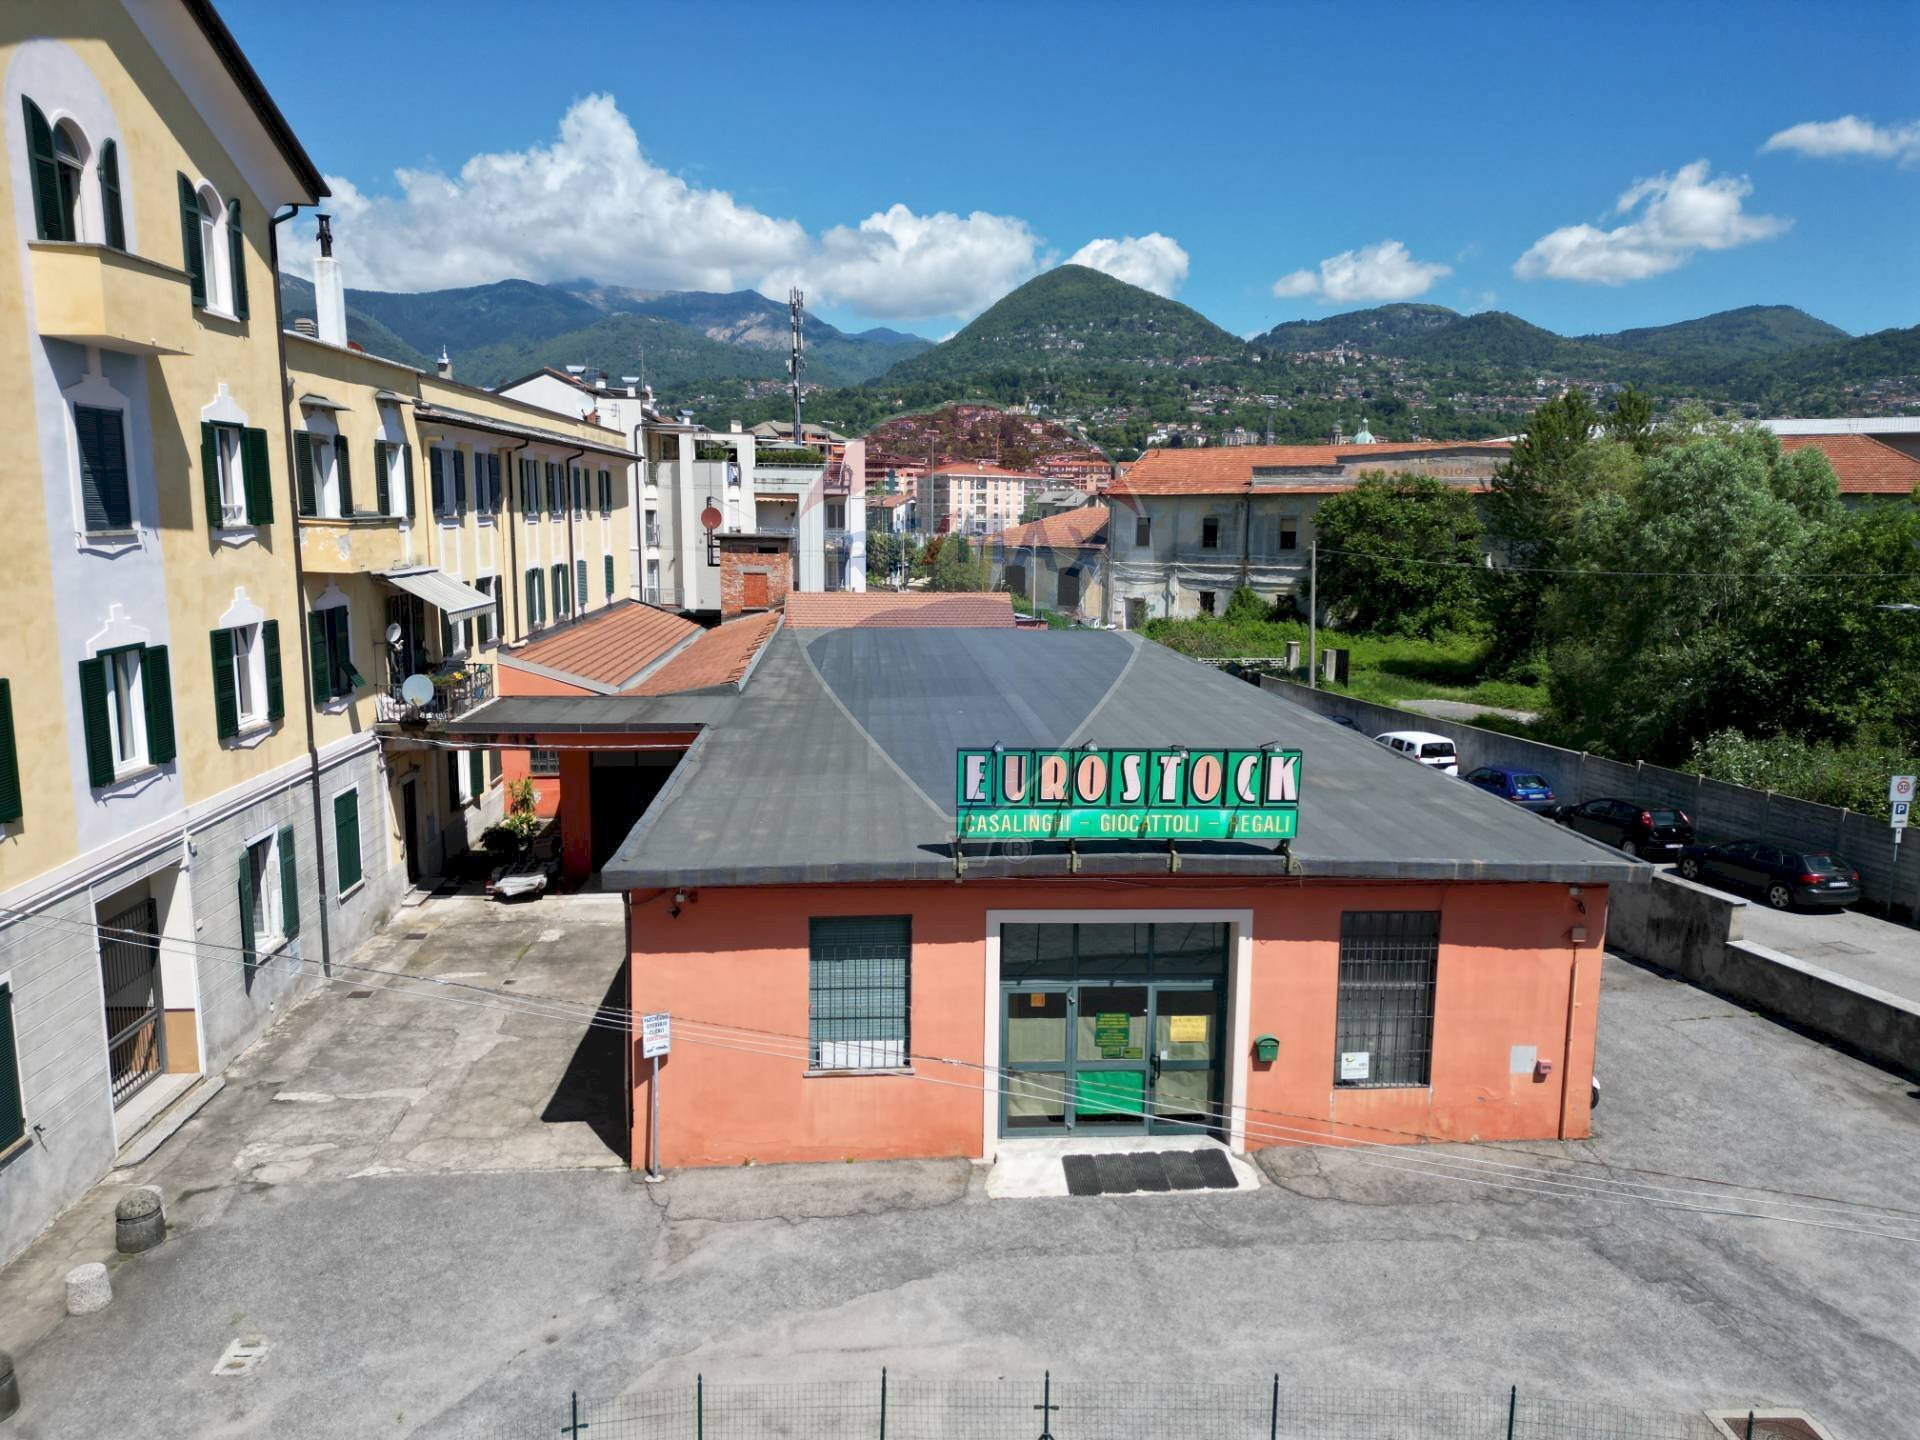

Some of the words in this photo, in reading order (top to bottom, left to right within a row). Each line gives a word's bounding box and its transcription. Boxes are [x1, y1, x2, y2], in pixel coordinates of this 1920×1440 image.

[965, 754, 1300, 802] EUROSTOCK
[965, 813, 1070, 833] CASALINGHI
[1100, 813, 1199, 833] GIOCATTOLI
